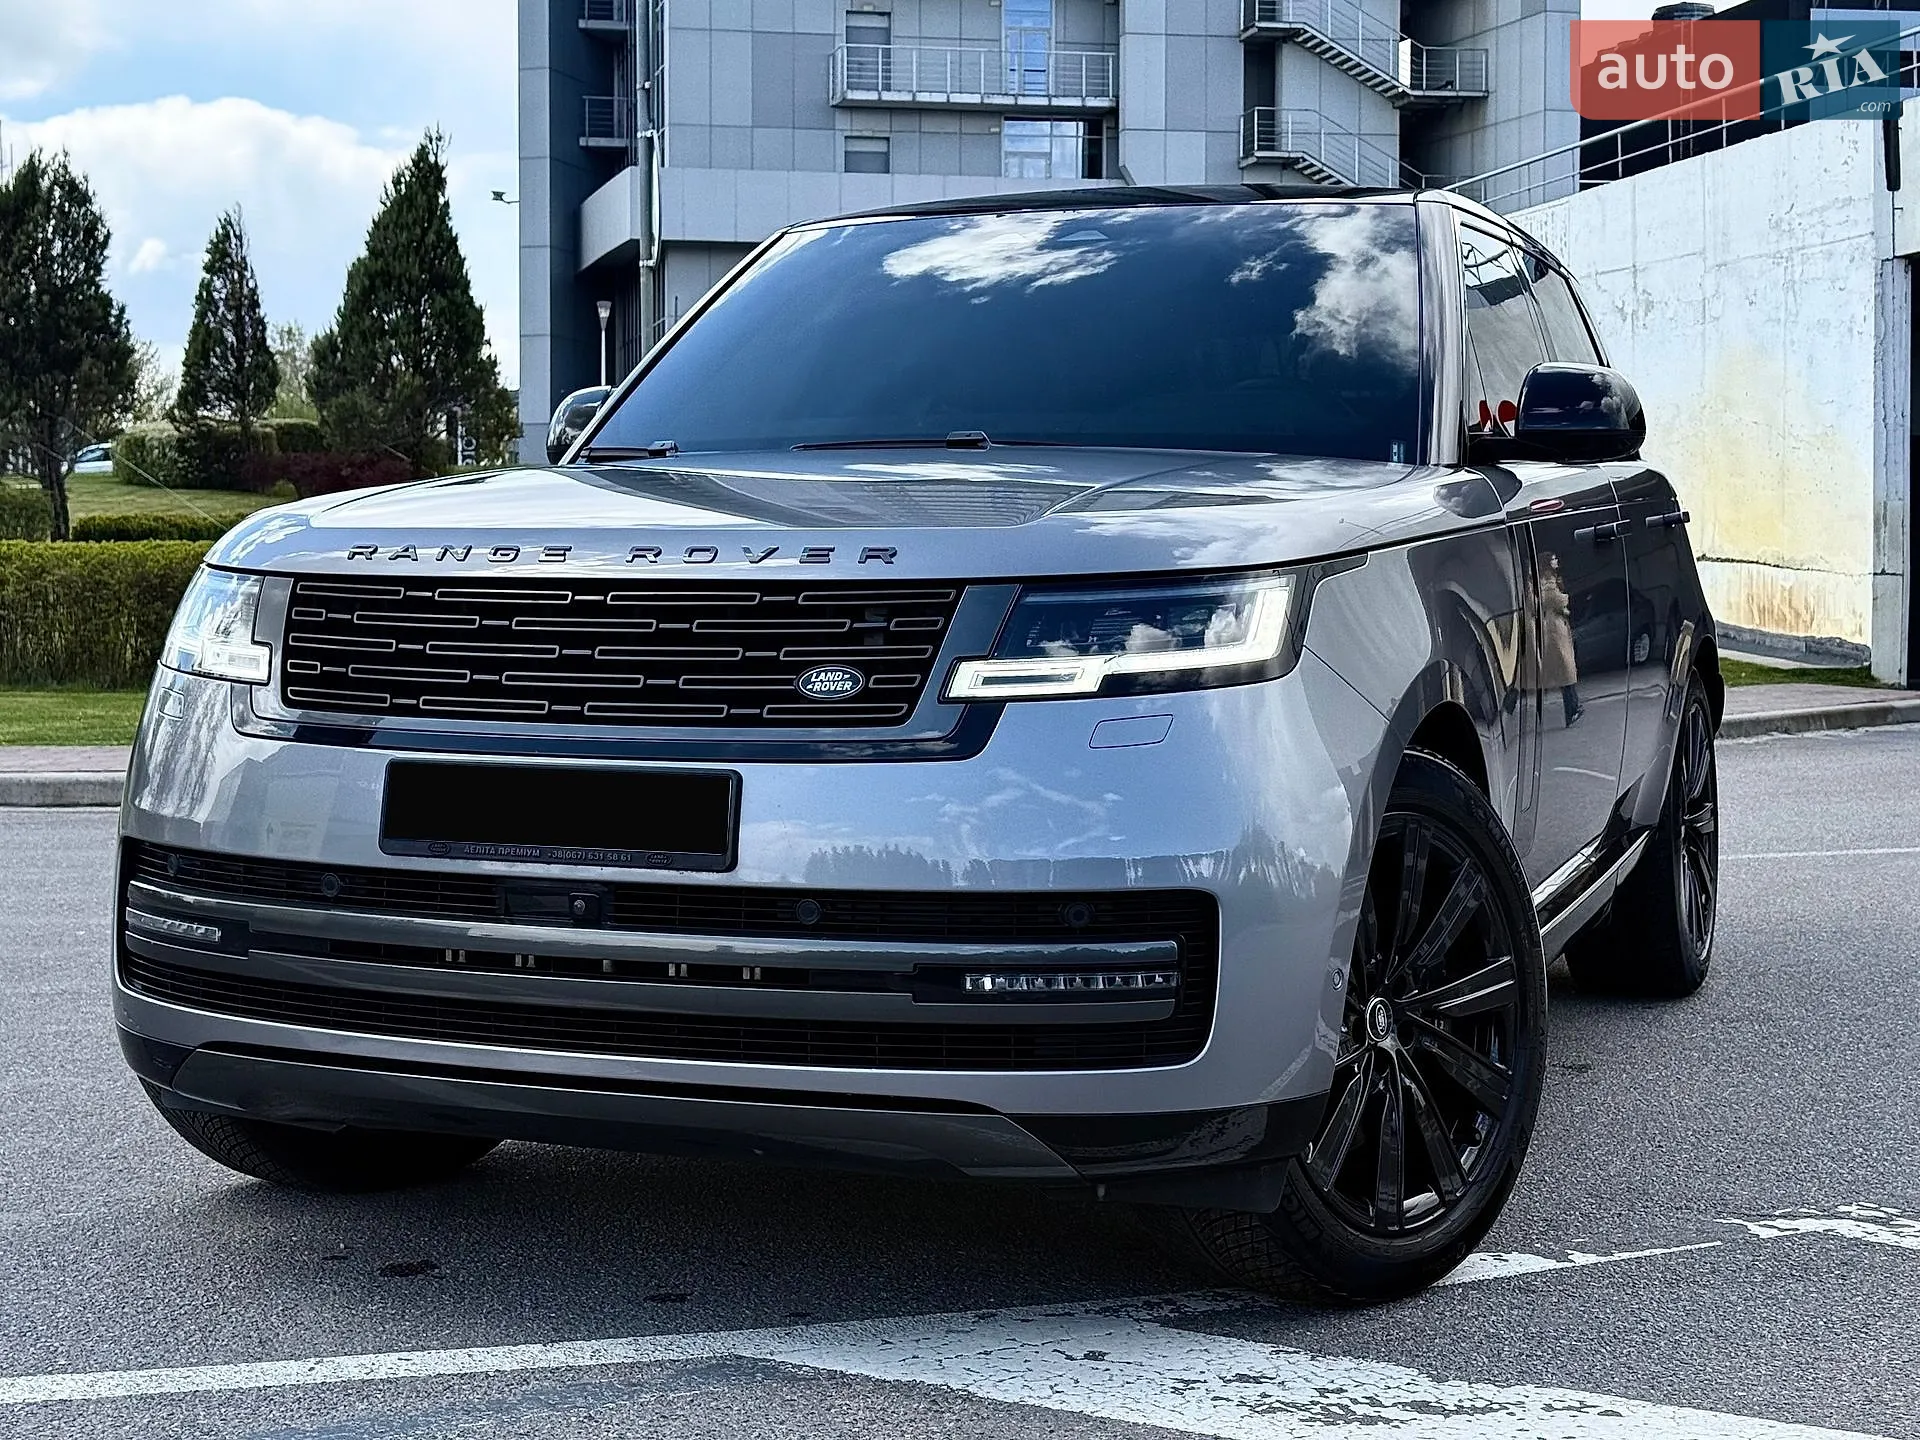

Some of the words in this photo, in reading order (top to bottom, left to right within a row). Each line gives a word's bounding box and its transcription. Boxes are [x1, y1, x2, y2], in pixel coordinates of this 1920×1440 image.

[346, 543, 574, 565] RANGE
[624, 544, 901, 566] ROVER
[811, 671, 844, 682] LAND
[812, 681, 853, 692] ROVER
